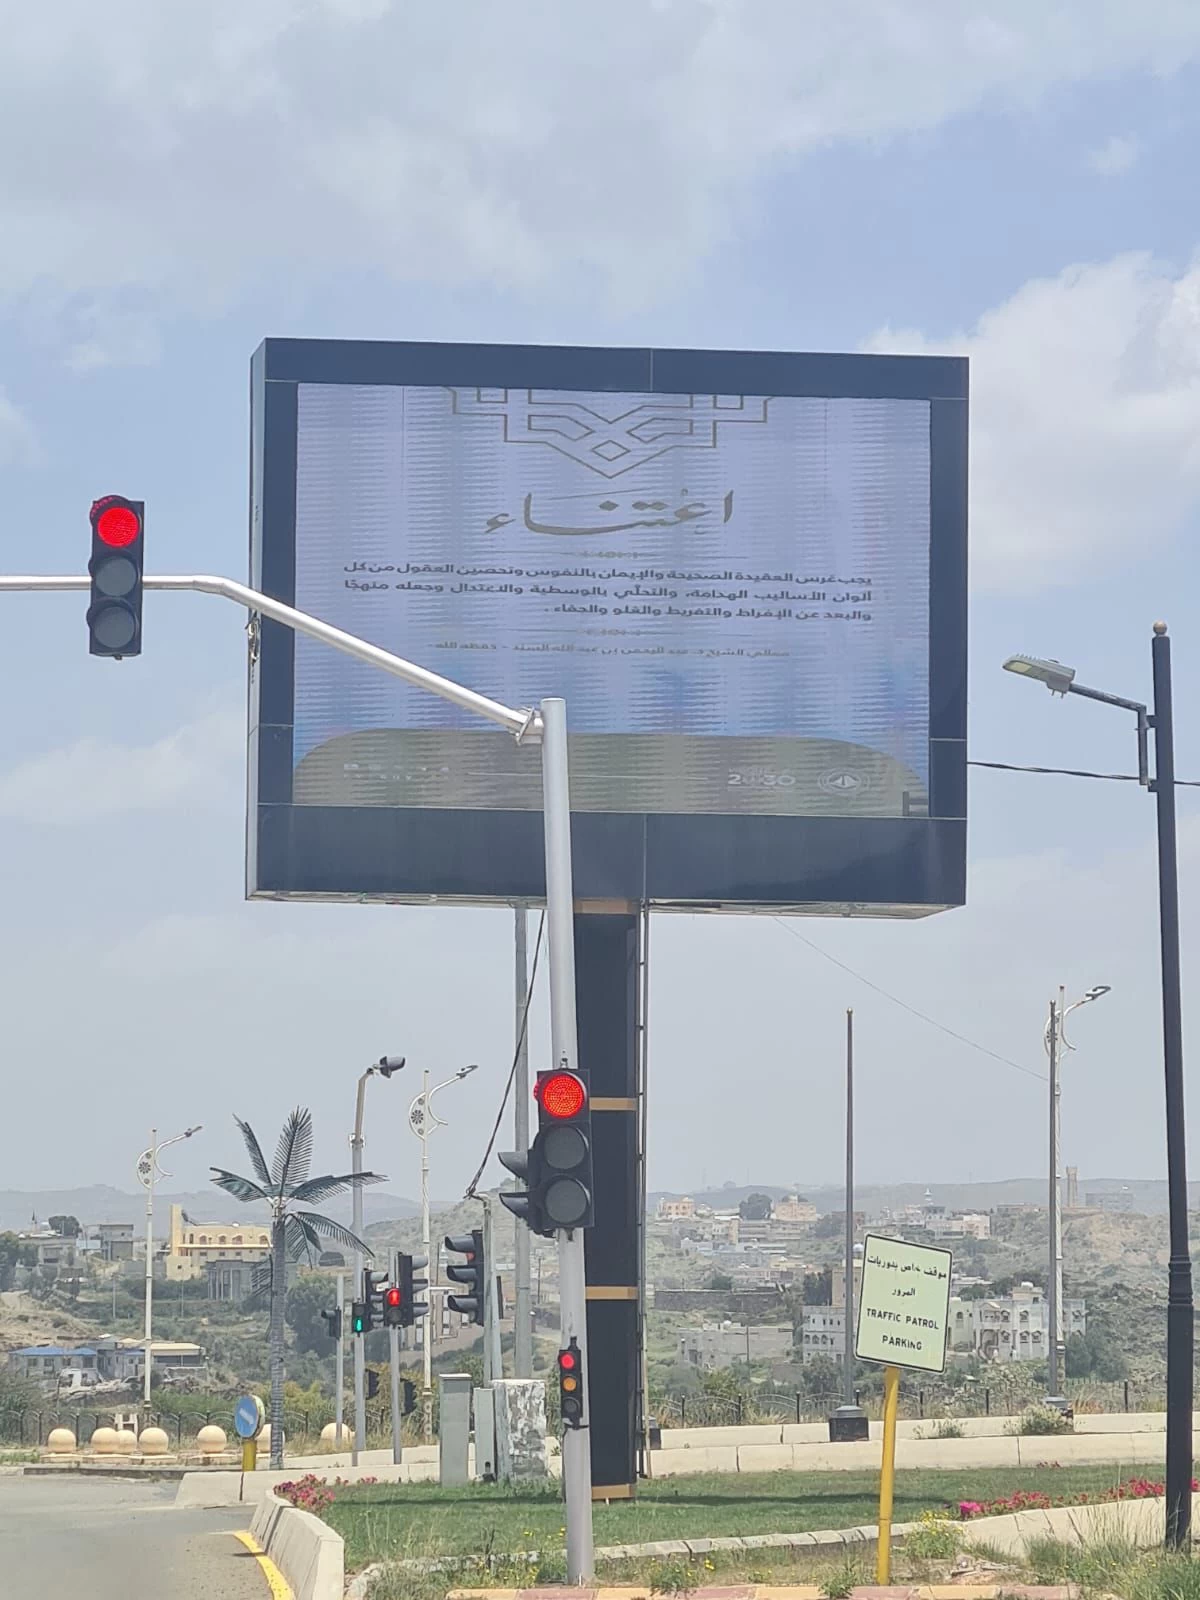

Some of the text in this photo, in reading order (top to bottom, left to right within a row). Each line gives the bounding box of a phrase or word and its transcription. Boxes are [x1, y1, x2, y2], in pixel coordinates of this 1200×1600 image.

[343, 561, 366, 573] كل
[368, 562, 395, 574] من
[397, 563, 454, 575] العقول
[456, 565, 523, 577] وتحصين
[525, 567, 596, 579] بالنفوس
[598, 569, 664, 580] والإيمان
[667, 570, 732, 581] الصحيحة
[735, 572, 793, 582] العقيدة
[795, 573, 838, 585] غرس
[395, 581, 444, 593] وجعله
[450, 582, 523, 595] والاعتدال
[529, 583, 607, 597] بالوسطية
[754, 590, 826, 602] الأساليب
[832, 589, 872, 603] ألوان
[612, 605, 662, 616] والغلو
[666, 606, 732, 618] والتفريط
[735, 608, 792, 620] الإفراط
[795, 608, 821, 620] عن
[823, 610, 872, 621] والبعد
[900, 1262, 921, 1273] خاص
[923, 1266, 947, 1280] موقف
[891, 1287, 916, 1297] المرور
[866, 1307, 940, 1330] TRAFFIC PATROL
[881, 1334, 923, 1351] PARKING
